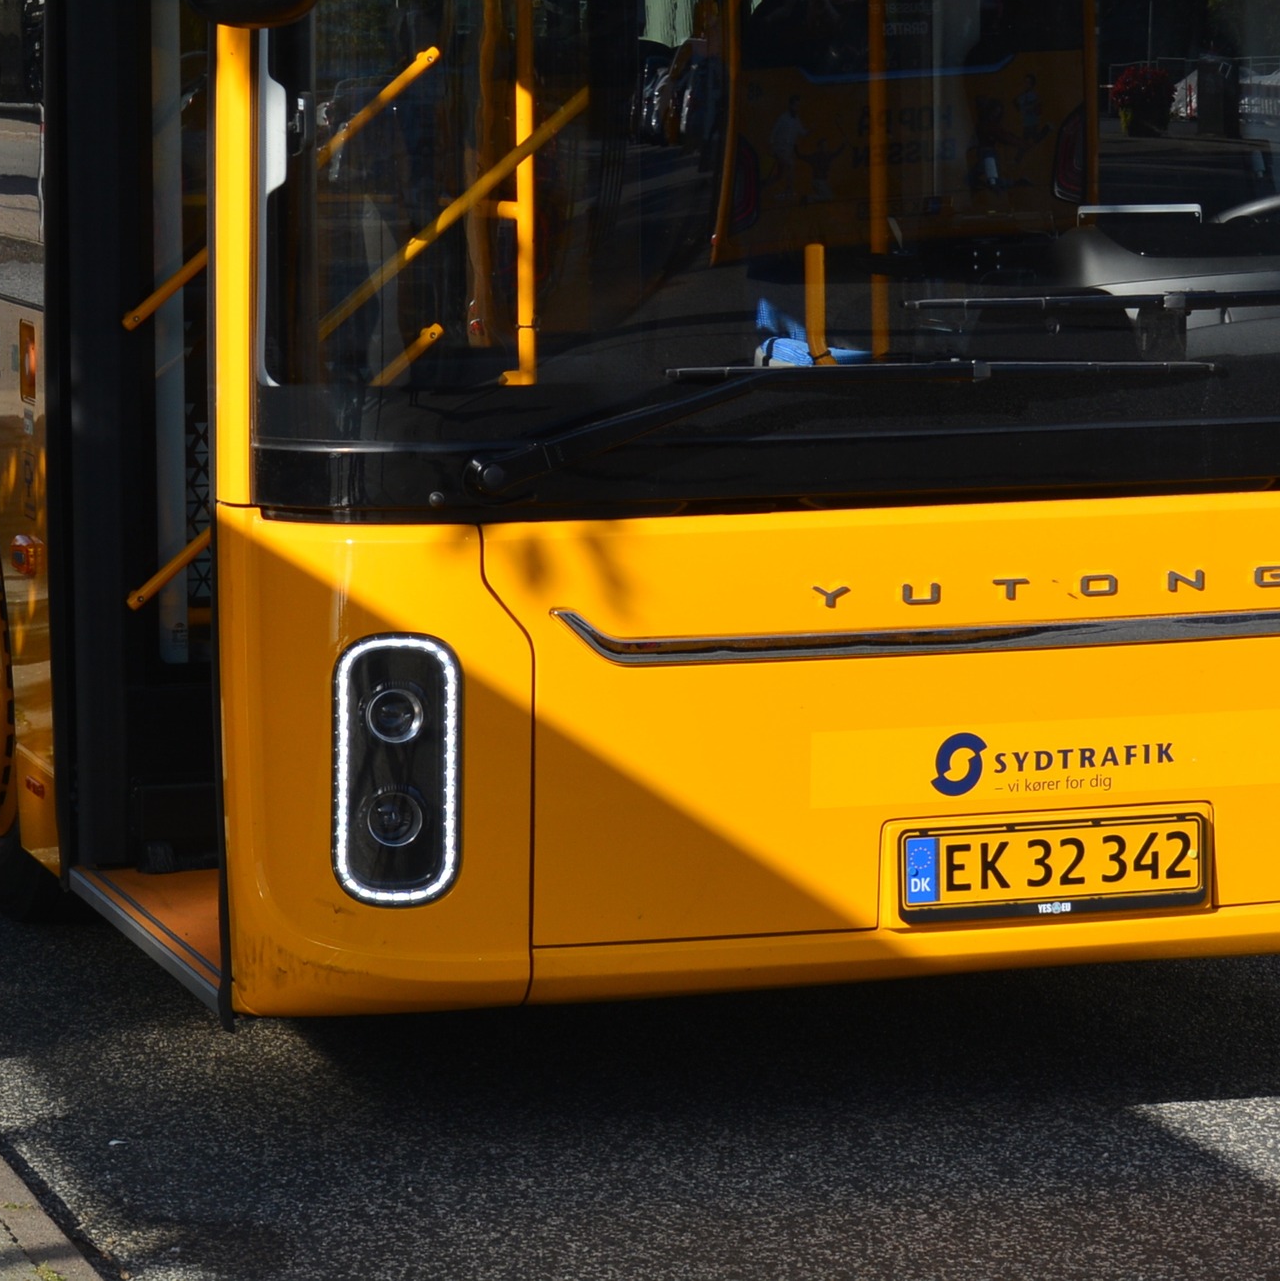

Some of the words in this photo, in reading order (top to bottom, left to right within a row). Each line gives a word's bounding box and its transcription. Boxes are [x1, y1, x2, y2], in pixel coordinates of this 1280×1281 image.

[993, 741, 1175, 774] SYDTRAFIK
[1008, 779, 1020, 793] vi
[1024, 775, 1060, 793] kører
[1065, 775, 1085, 790] for
[1090, 773, 1112, 791] dig
[945, 840, 1012, 892] EK
[1026, 837, 1086, 888] 32
[1100, 830, 1192, 883] 342
[910, 876, 931, 893] DK
